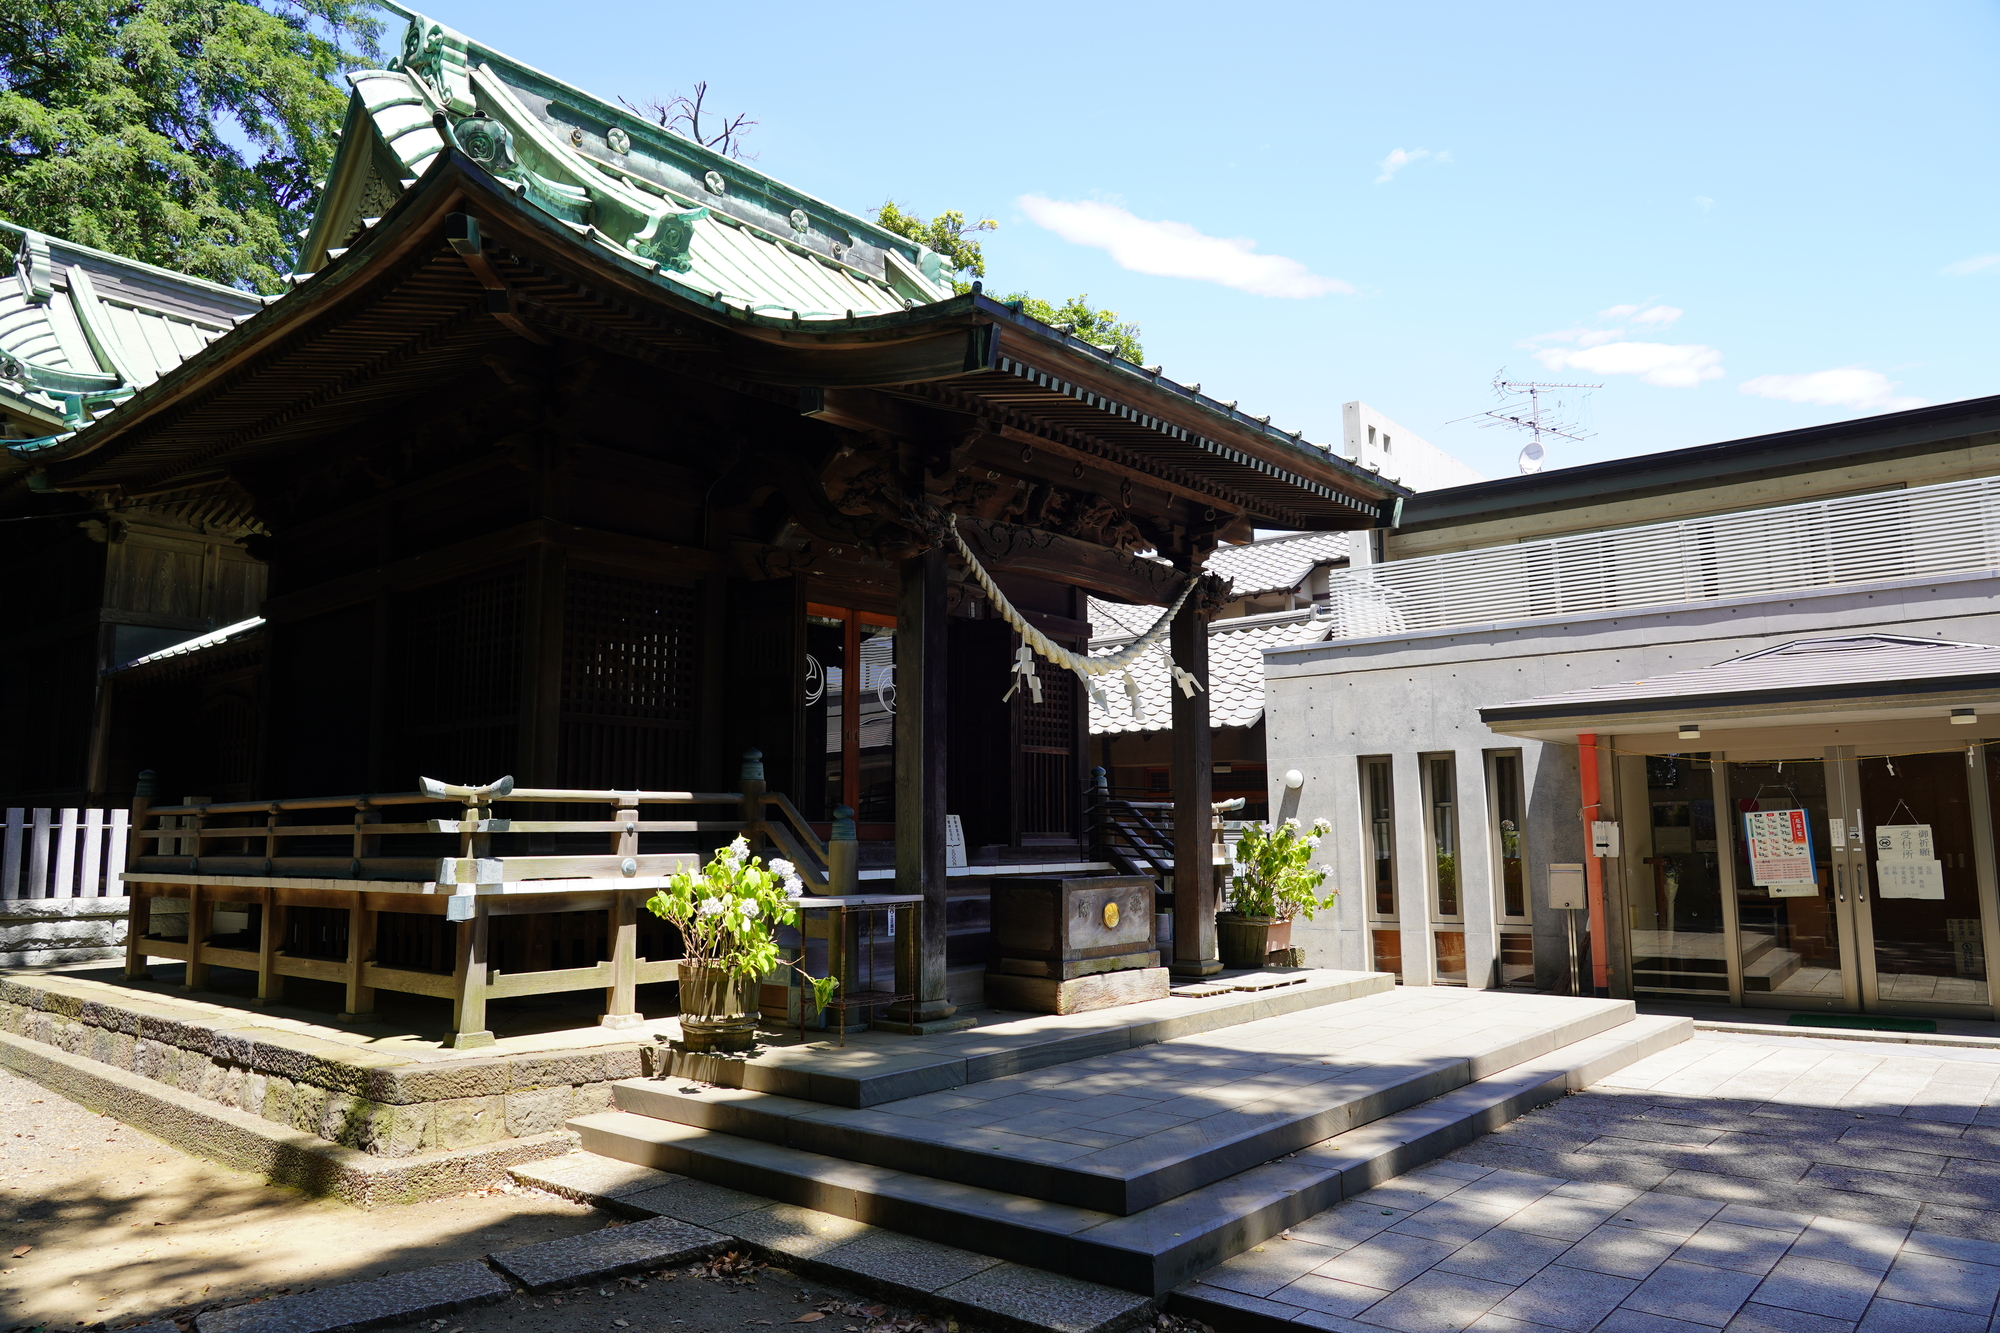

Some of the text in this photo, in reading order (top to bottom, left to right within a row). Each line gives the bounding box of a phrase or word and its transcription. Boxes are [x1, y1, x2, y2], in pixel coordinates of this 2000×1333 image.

[1900, 830, 1914, 859] 受付所
[1918, 830, 1931, 857] 御祈願
[1900, 865, 1908, 885] 学業成就
